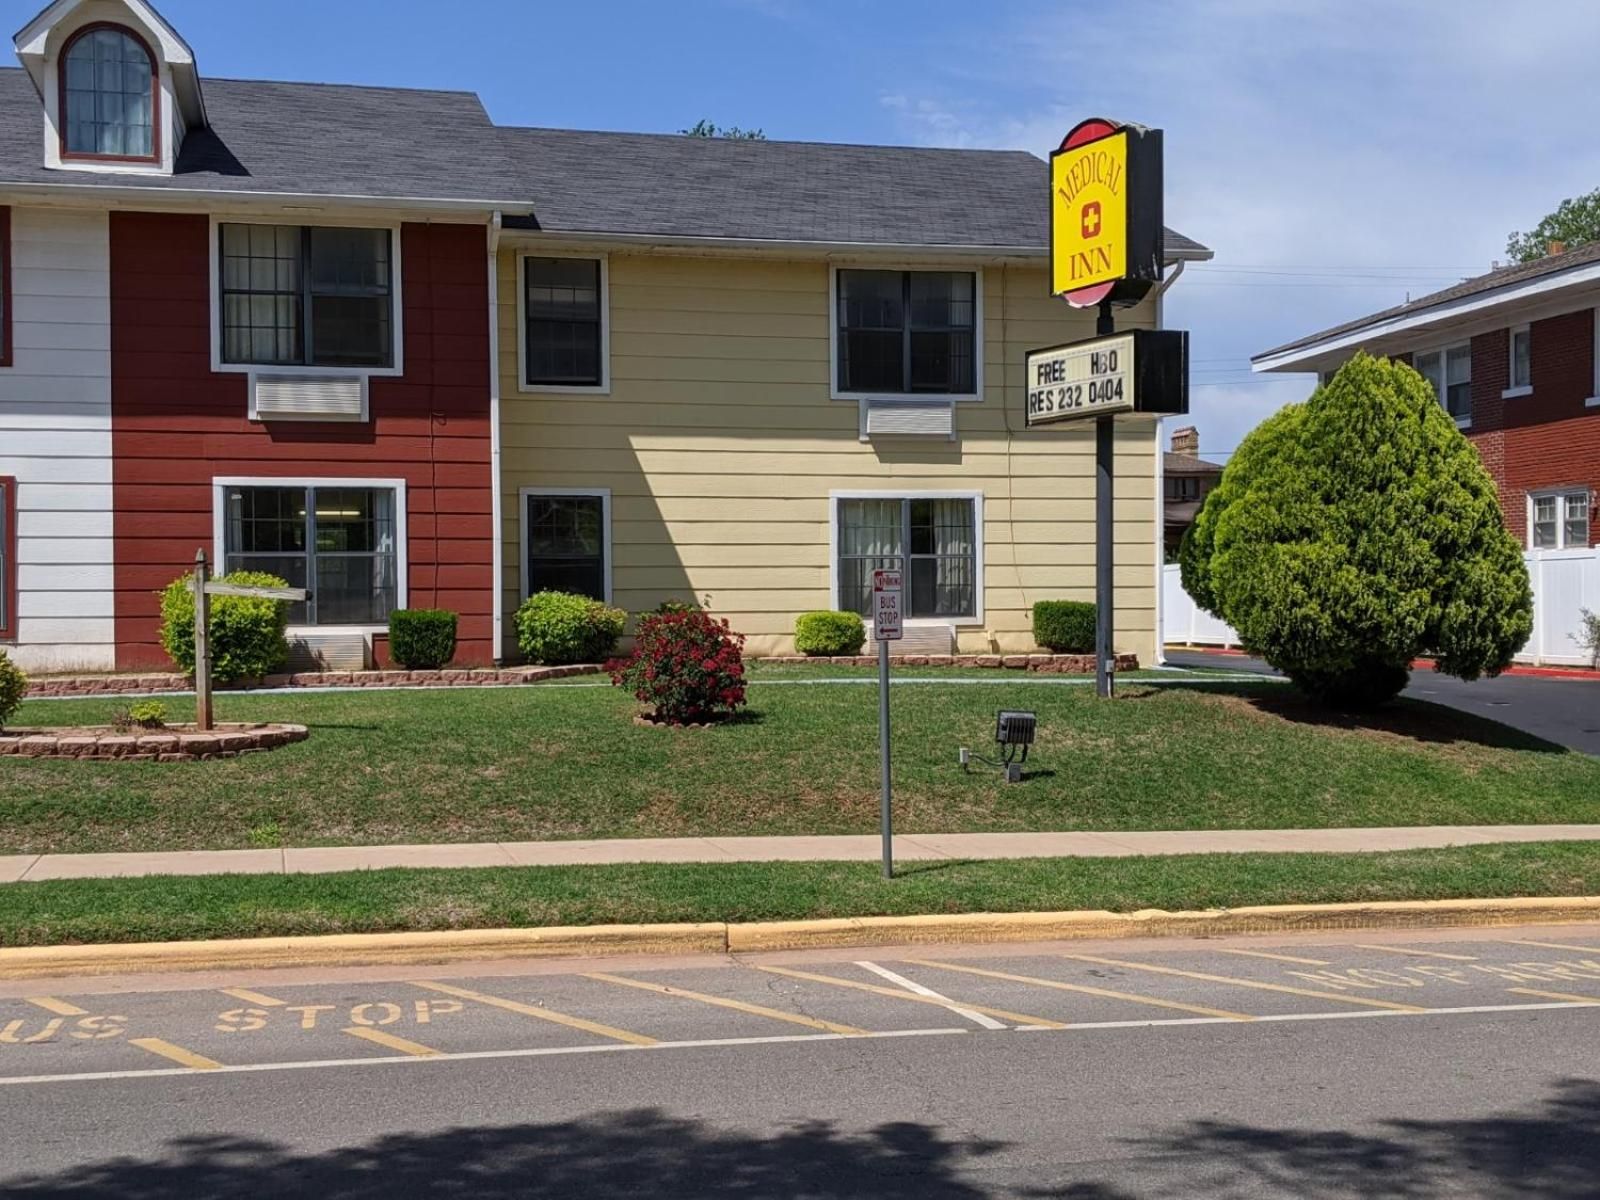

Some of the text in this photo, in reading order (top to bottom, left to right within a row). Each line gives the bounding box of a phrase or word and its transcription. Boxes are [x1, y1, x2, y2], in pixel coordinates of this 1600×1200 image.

[1058, 151, 1122, 208] MEDICAL
[1069, 243, 1113, 281] INN
[1037, 350, 1118, 386] FREE HBO
[1029, 378, 1124, 414] RES 232 0404
[879, 611, 898, 625] STOP
[880, 596, 896, 609] BUS
[214, 1000, 464, 1033] STOP
